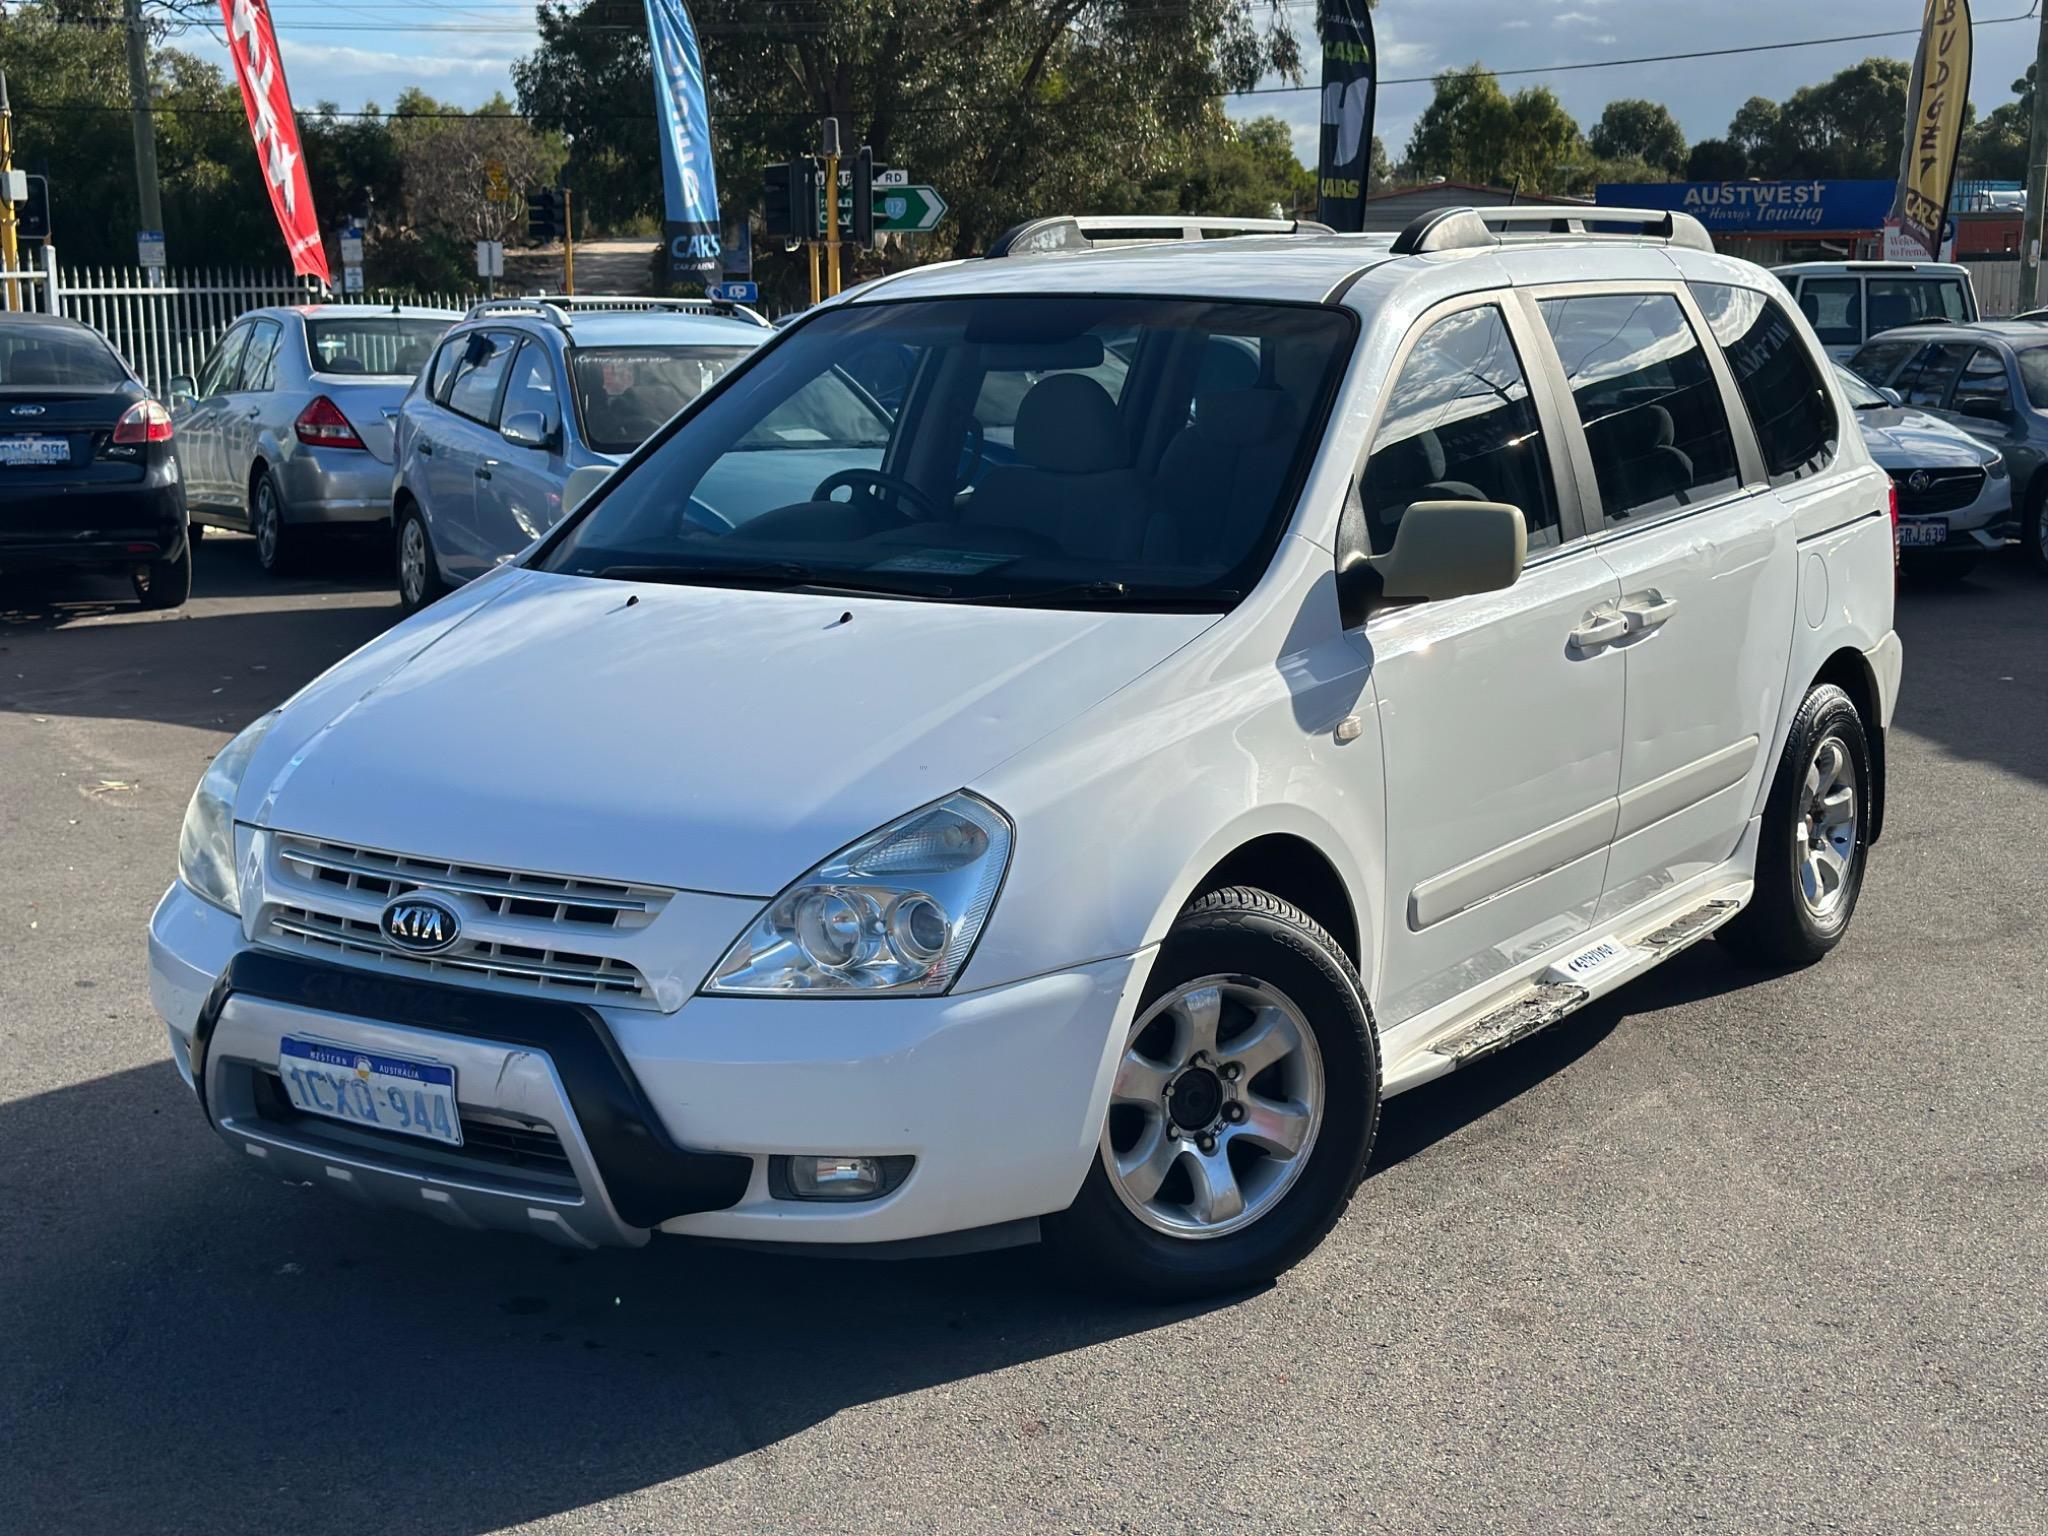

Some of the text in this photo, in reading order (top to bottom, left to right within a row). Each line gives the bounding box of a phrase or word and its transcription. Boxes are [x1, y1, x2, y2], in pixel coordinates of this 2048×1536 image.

[885, 172, 903, 182] RD
[1321, 178, 1361, 199] ARS
[1683, 184, 1826, 205] AUSTWEST
[1756, 202, 1825, 225] Towing
[1904, 193, 1940, 231] CARS
[671, 234, 721, 258] CARS
[391, 906, 443, 941] KIA
[310, 1051, 420, 1079] WESTERN AUSTRALIA
